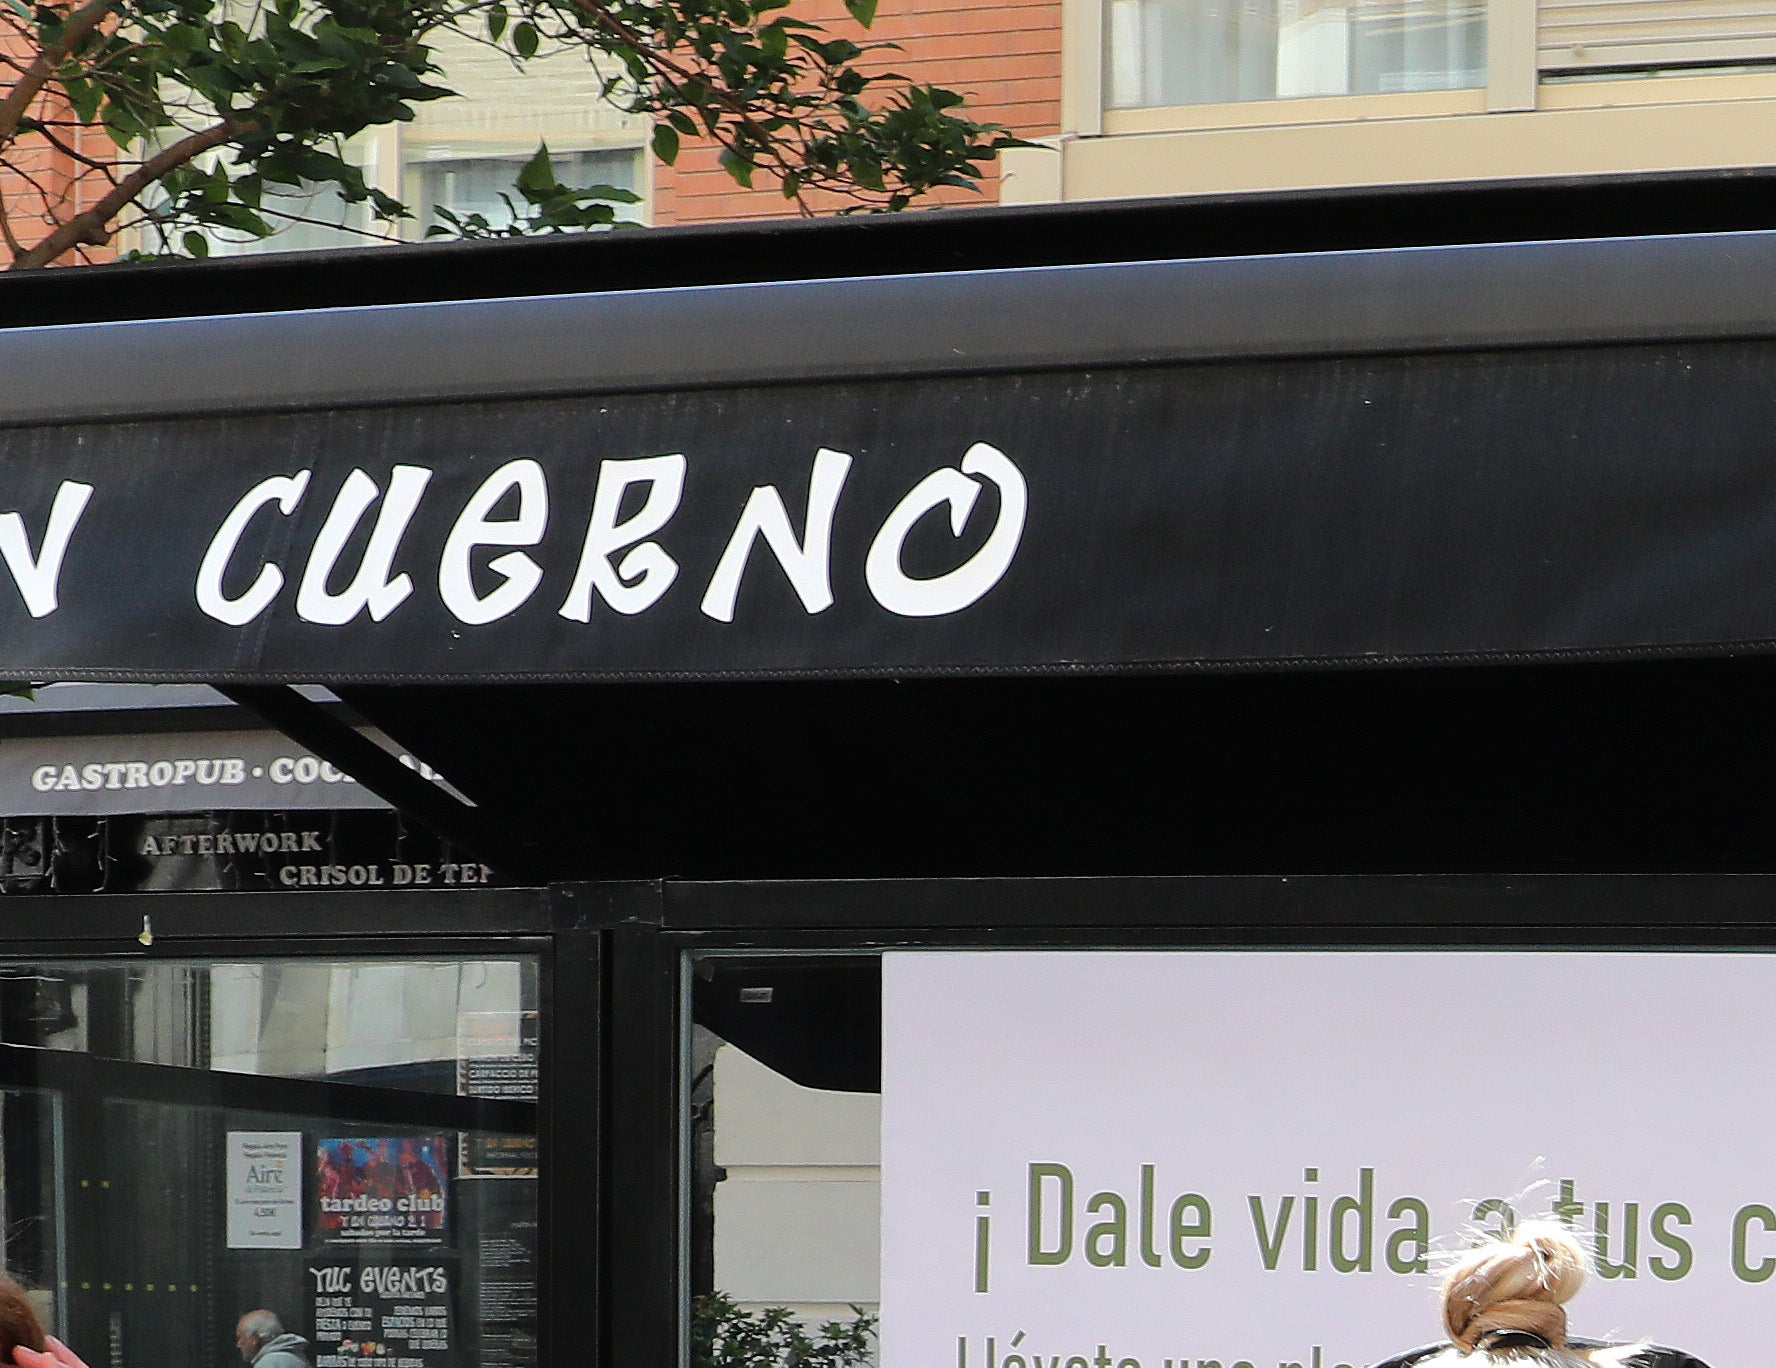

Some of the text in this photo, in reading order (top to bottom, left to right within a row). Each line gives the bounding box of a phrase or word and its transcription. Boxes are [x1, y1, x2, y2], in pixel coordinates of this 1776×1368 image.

[194, 441, 1028, 628] CUERNO
[32, 757, 246, 792] GASTROPUB
[139, 831, 322, 857] AFTERWORK
[278, 864, 384, 886] CRISOL
[393, 864, 432, 885] DE
[320, 1194, 445, 1213] tardeo club
[1026, 1161, 1214, 1270] Dale
[1248, 1166, 1430, 1274] vida
